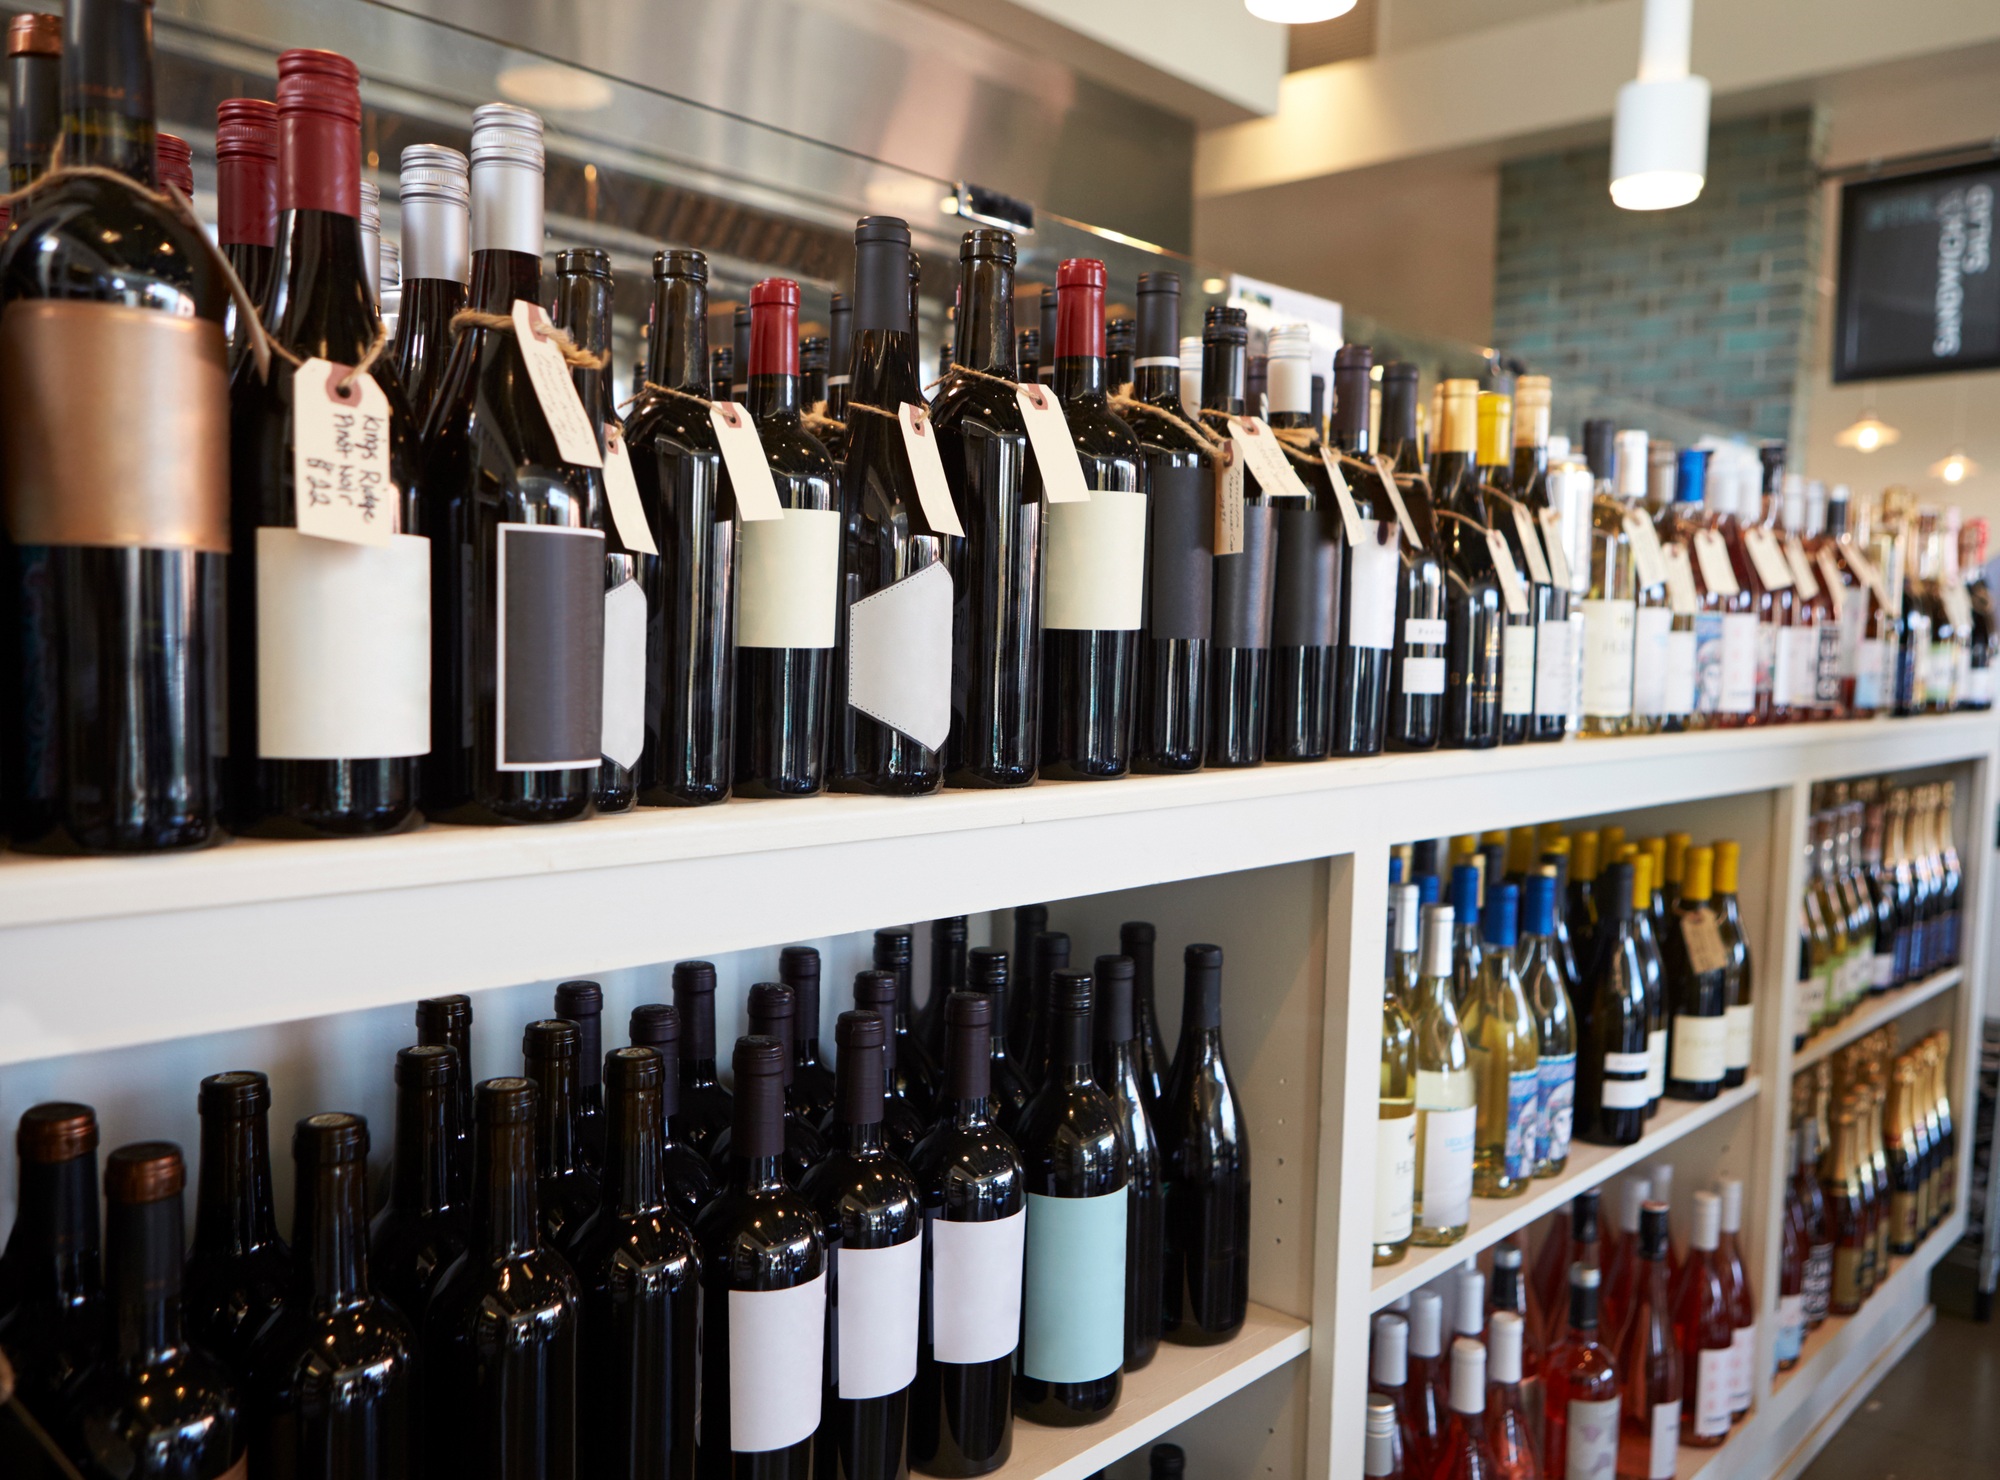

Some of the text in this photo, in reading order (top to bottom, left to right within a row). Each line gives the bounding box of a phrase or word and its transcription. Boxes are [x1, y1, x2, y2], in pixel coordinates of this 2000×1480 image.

[333, 412, 359, 506] Pinot Noir
[356, 413, 388, 525] Kings Ridge
